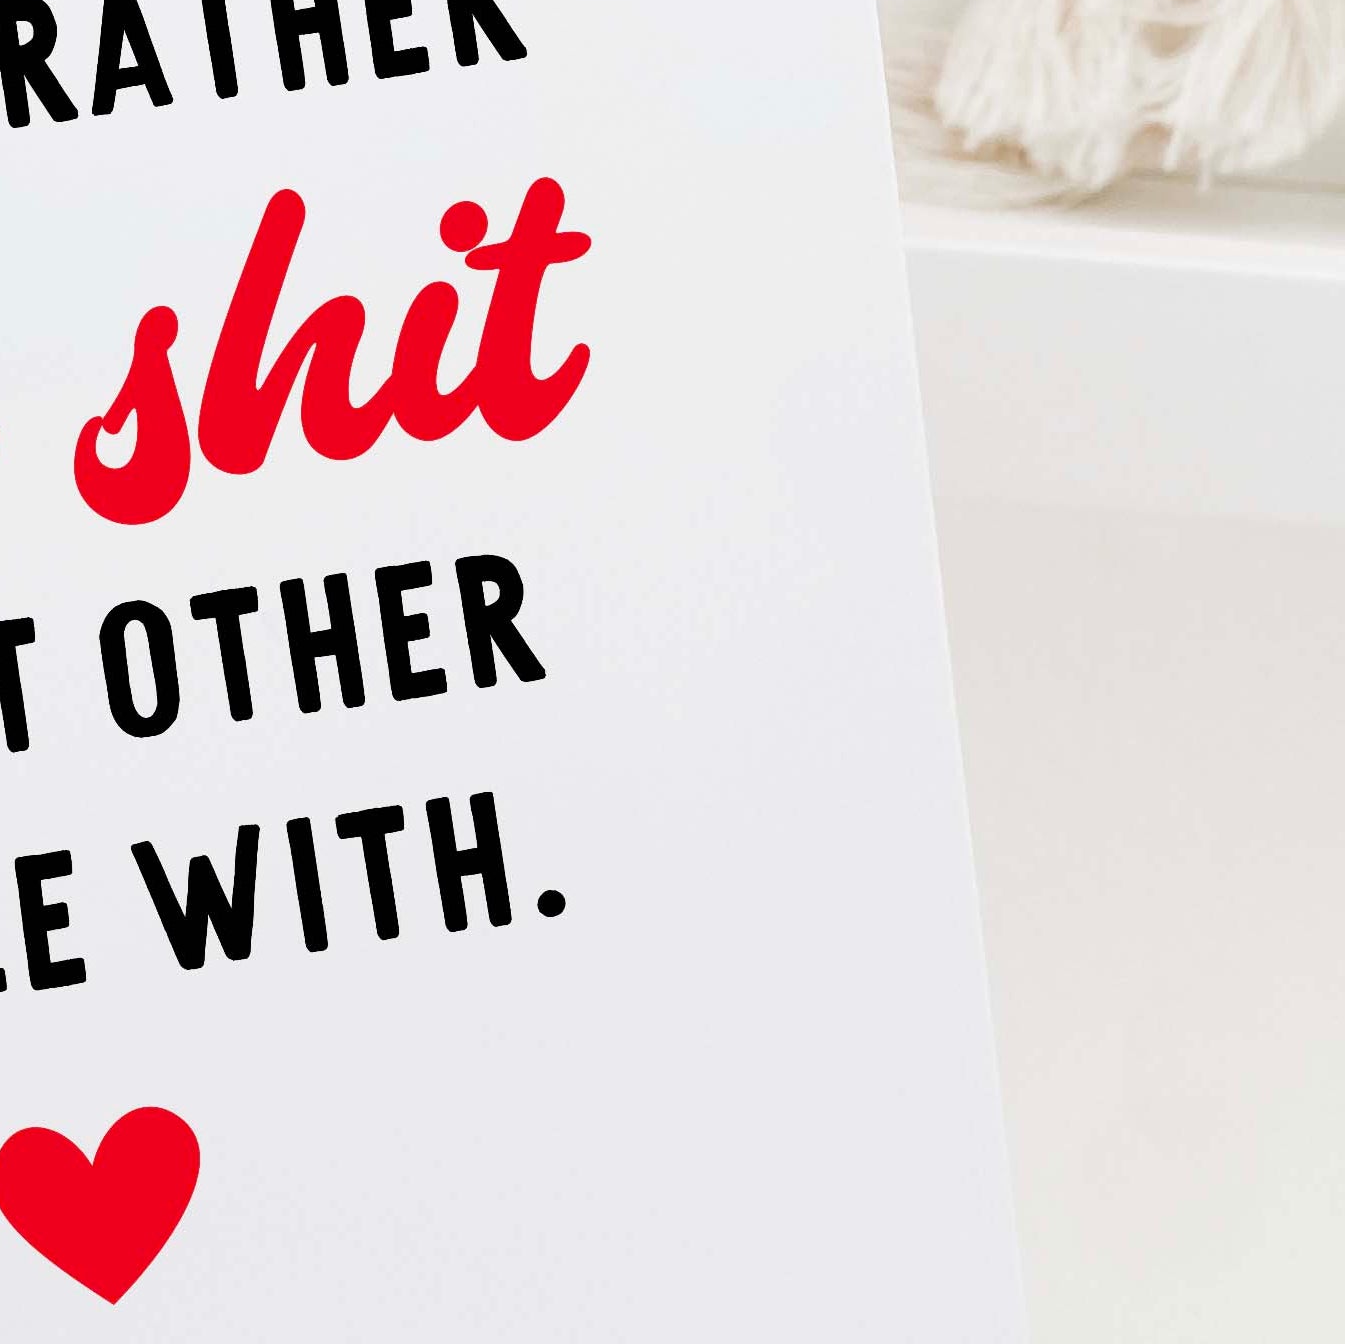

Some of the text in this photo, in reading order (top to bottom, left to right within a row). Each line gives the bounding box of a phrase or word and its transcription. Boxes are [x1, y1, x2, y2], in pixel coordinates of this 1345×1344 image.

[73, 176, 592, 526] shit
[98, 554, 547, 739] OTHER
[130, 791, 567, 971] WITH.
